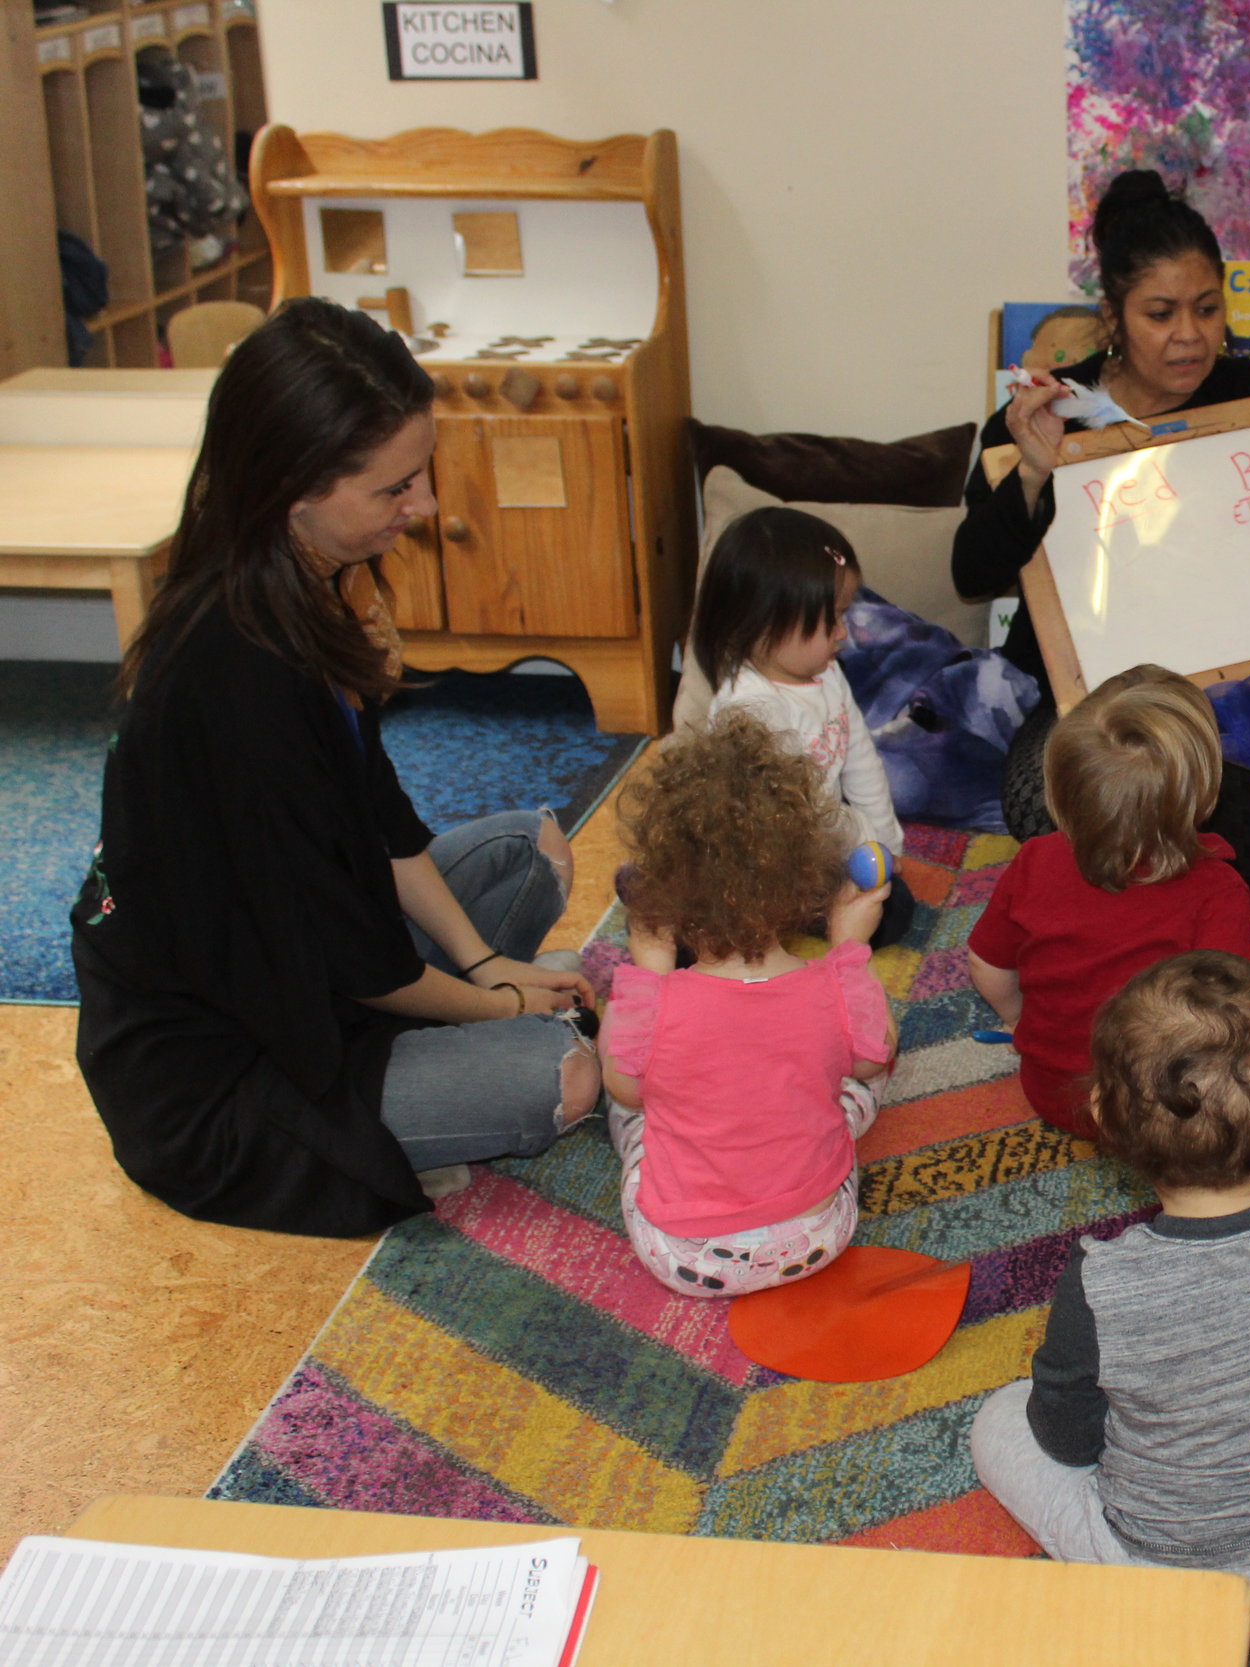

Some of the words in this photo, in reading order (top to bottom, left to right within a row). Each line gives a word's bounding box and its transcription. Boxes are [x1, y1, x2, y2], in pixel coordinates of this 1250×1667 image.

[402, 11, 515, 33] KITCHEN
[412, 42, 512, 64] COCINA
[1082, 461, 1179, 515] Red
